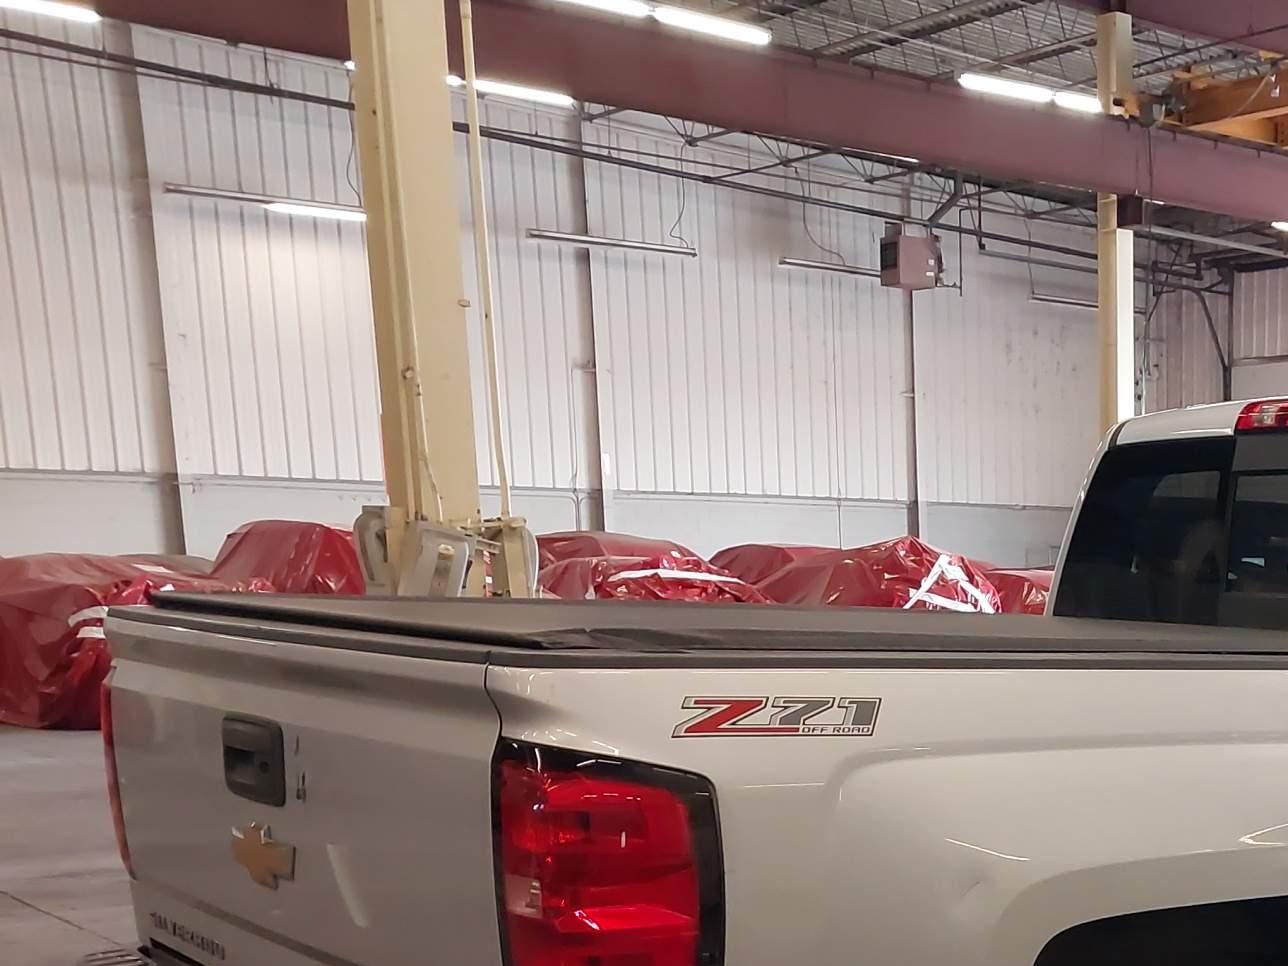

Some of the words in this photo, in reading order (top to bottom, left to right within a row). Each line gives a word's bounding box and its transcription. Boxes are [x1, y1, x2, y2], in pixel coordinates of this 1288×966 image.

[671, 696, 882, 738] Z71
[801, 726, 832, 734] OFF
[832, 726, 870, 734] ROAD
